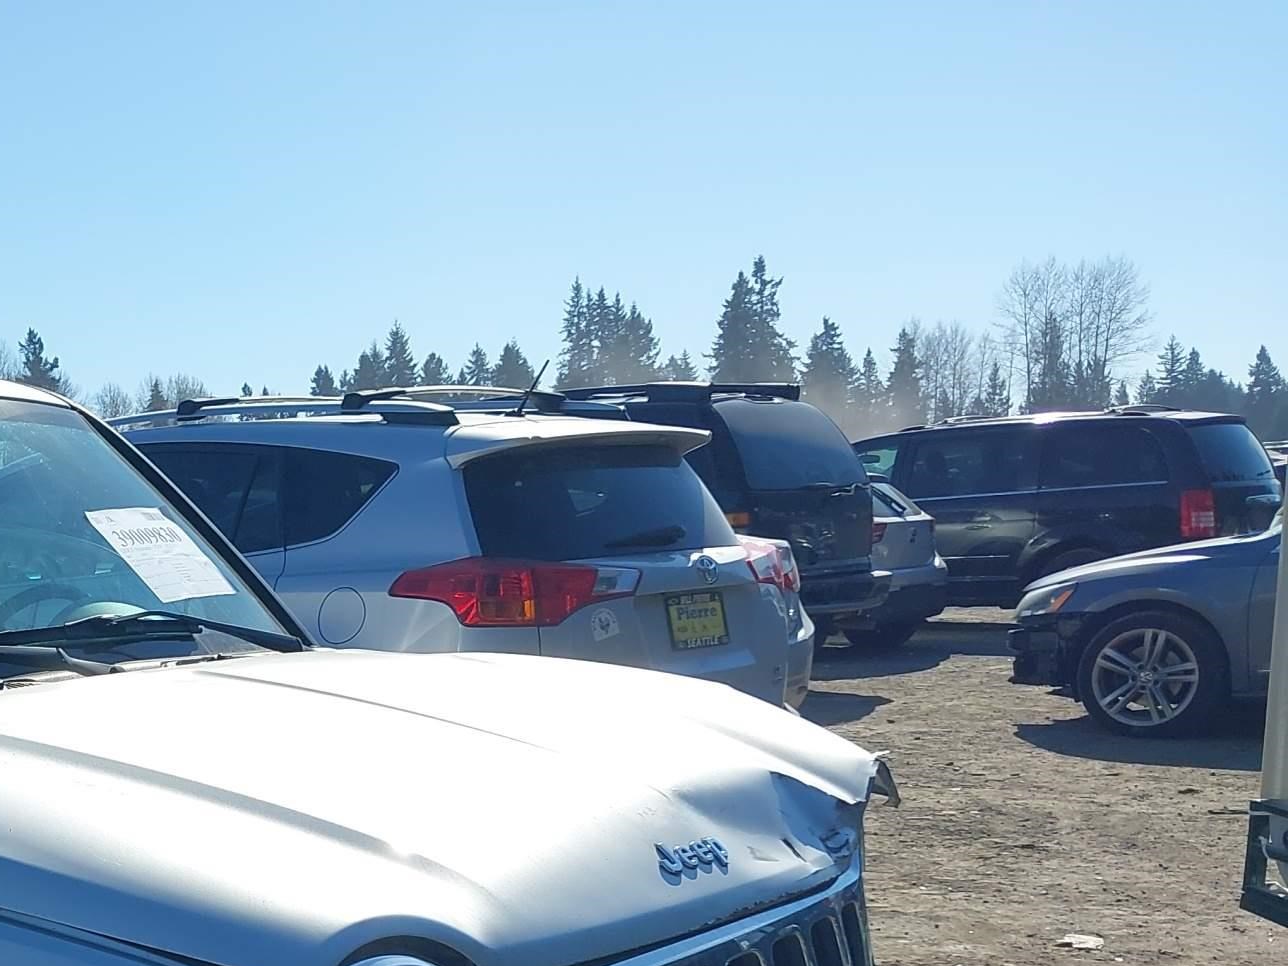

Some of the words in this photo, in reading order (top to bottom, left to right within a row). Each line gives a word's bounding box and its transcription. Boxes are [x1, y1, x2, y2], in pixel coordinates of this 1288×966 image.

[112, 526, 182, 547] 39009830
[678, 606, 717, 620] Pierre
[687, 635, 719, 648] SEATTLE
[654, 837, 730, 873] Jeep
